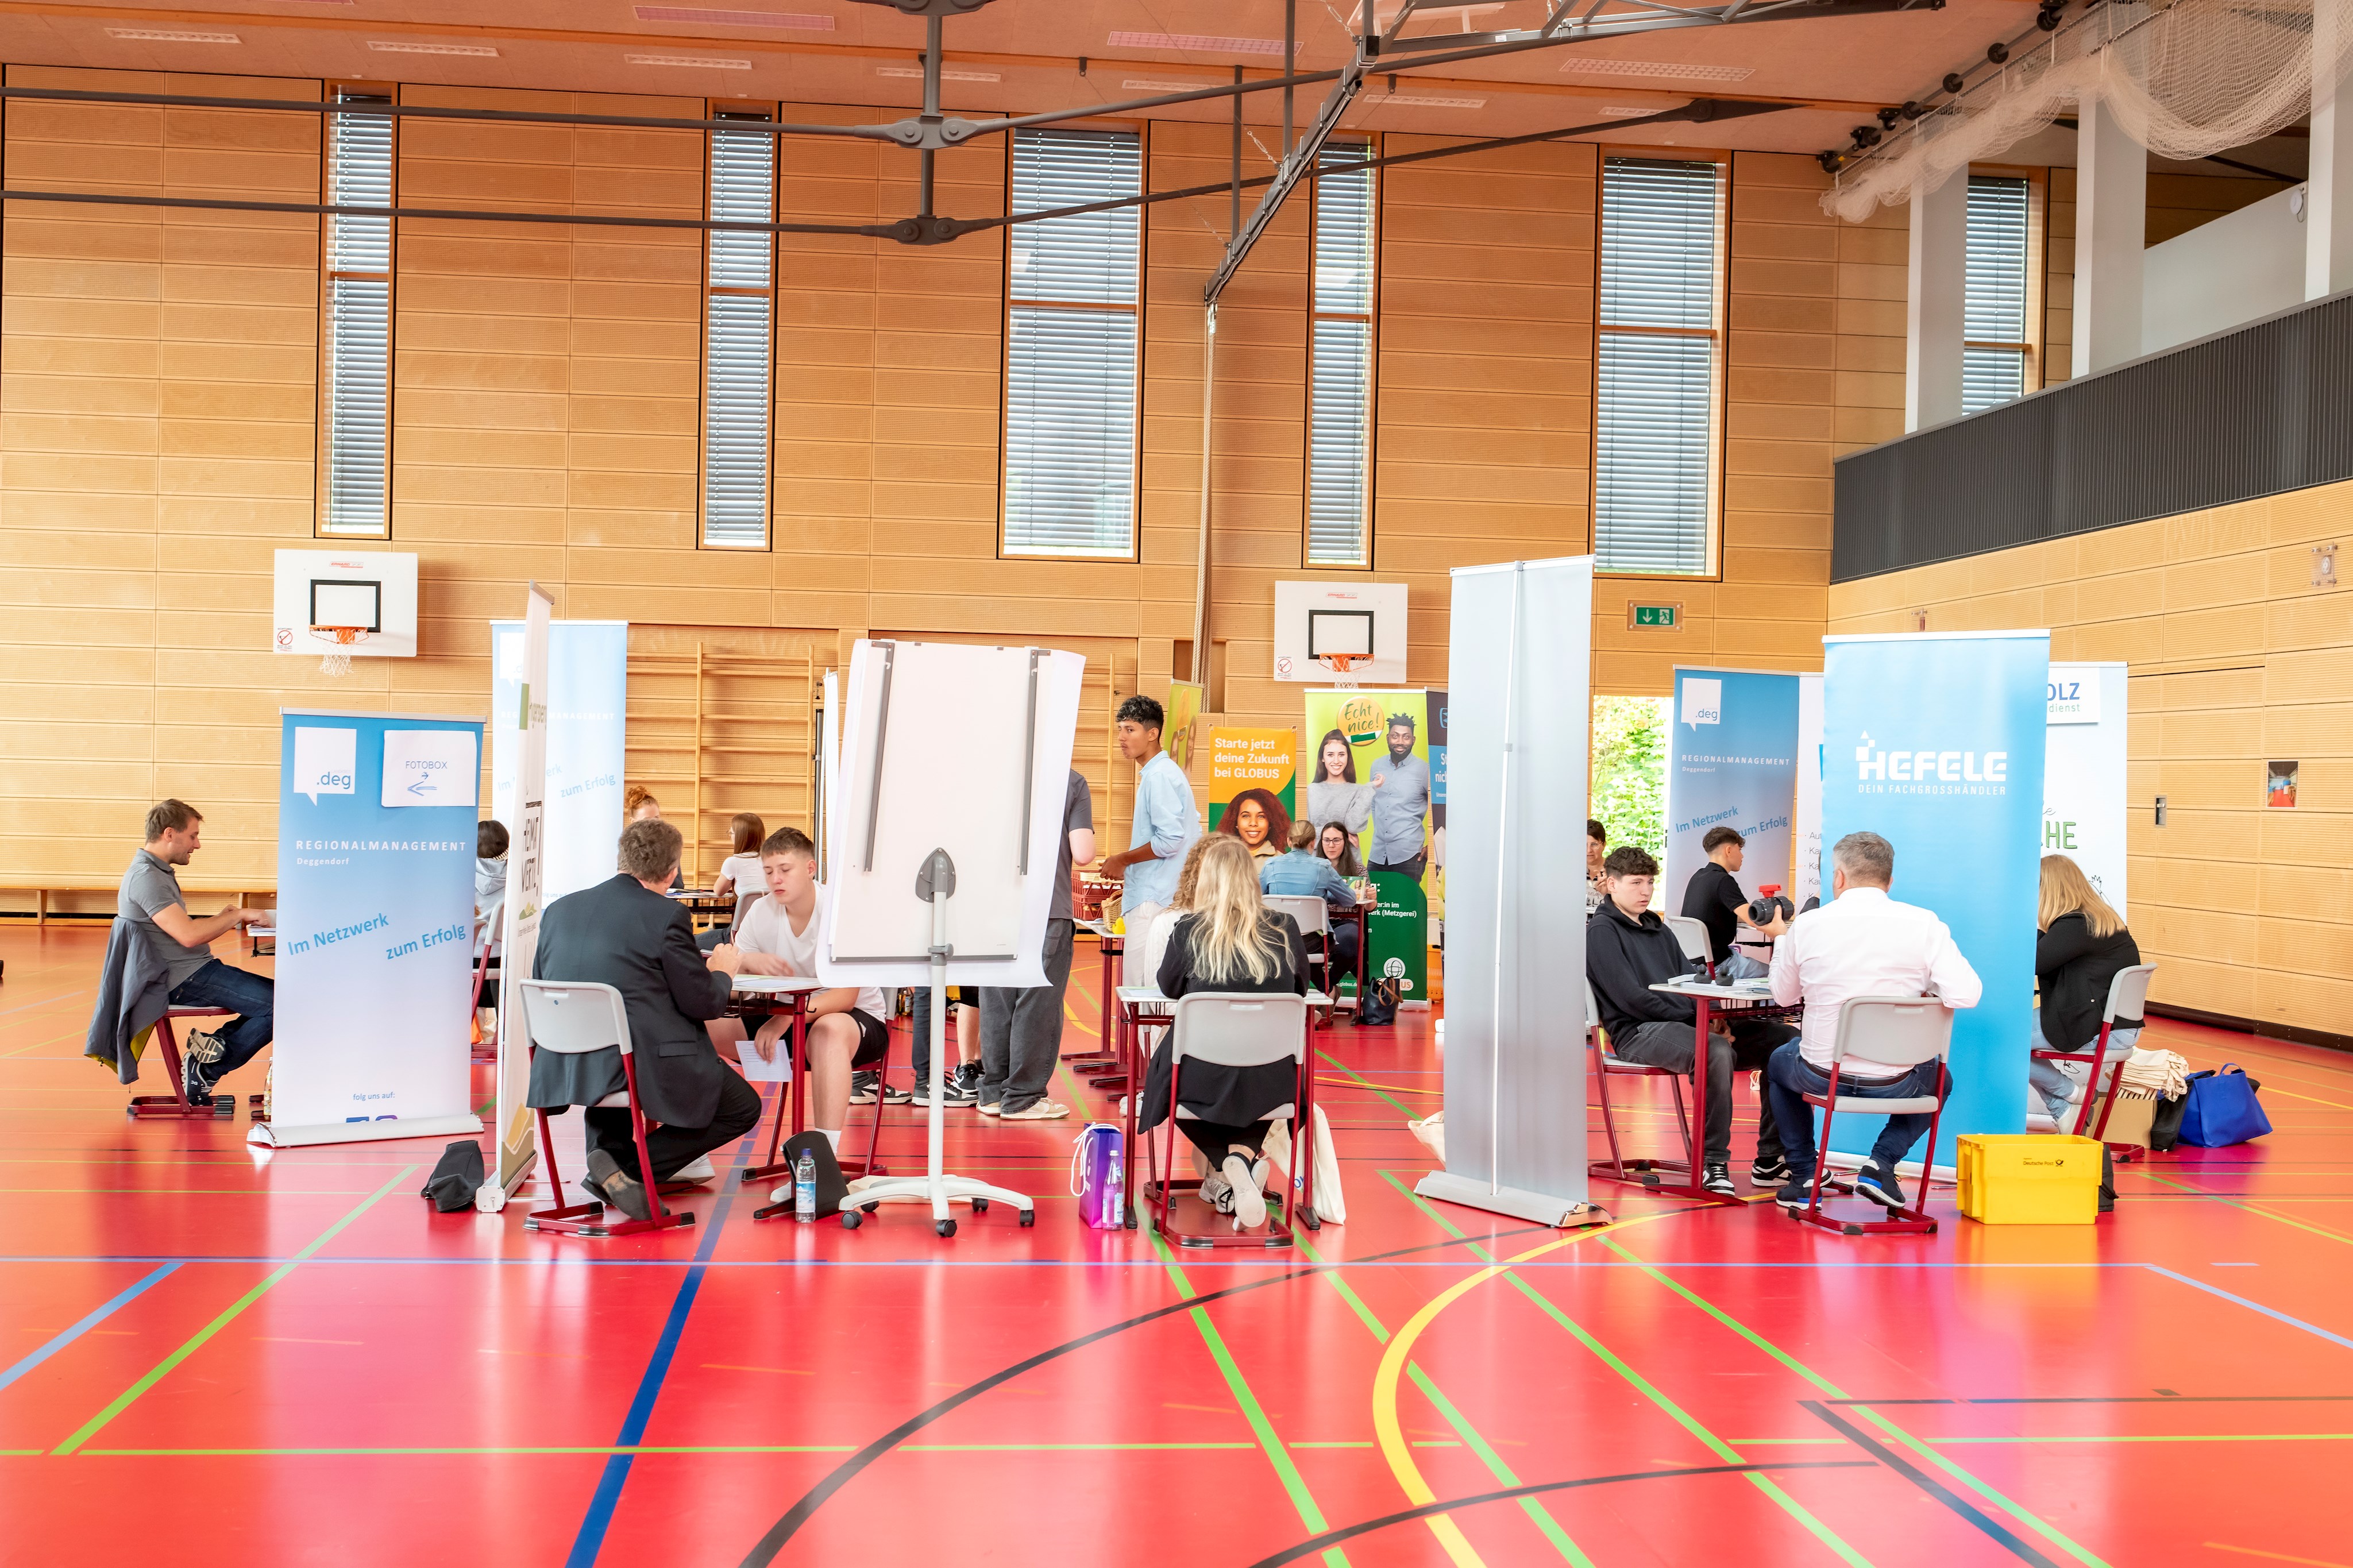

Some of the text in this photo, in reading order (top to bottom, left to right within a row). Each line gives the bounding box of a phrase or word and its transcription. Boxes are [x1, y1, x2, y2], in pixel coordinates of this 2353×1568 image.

[2047, 682, 2080, 701] OLZ
[1344, 702, 1372, 720] Echt
[1696, 708, 1718, 721] .deg
[1348, 712, 1379, 733] nice!
[1215, 737, 1275, 751] Starte jetzt
[406, 761, 448, 769] FOTOBOX
[1214, 752, 1290, 764] deine Zukunft
[1681, 754, 1790, 766] REGIONALMANAGEMENT
[1856, 747, 2007, 782] HEFELE
[317, 771, 351, 789] .deg
[1214, 767, 1280, 779] bei GLOBUS
[560, 774, 616, 798] zum Erfolg
[1858, 784, 2006, 795] DEIN FACHGROSSHÄNDLER
[1676, 806, 1739, 833] Im Netzwerk
[1737, 816, 1788, 838] zum Erfolg
[2046, 821, 2078, 849] HE
[296, 840, 466, 851] REGIONALMANAGEMENT
[296, 858, 350, 866] Deggendorf
[1382, 910, 1417, 918] (Metzgerei)
[288, 913, 389, 956] Im Netzwerk
[385, 925, 466, 960] zum Erfolg
[353, 1094, 366, 1102] folg
